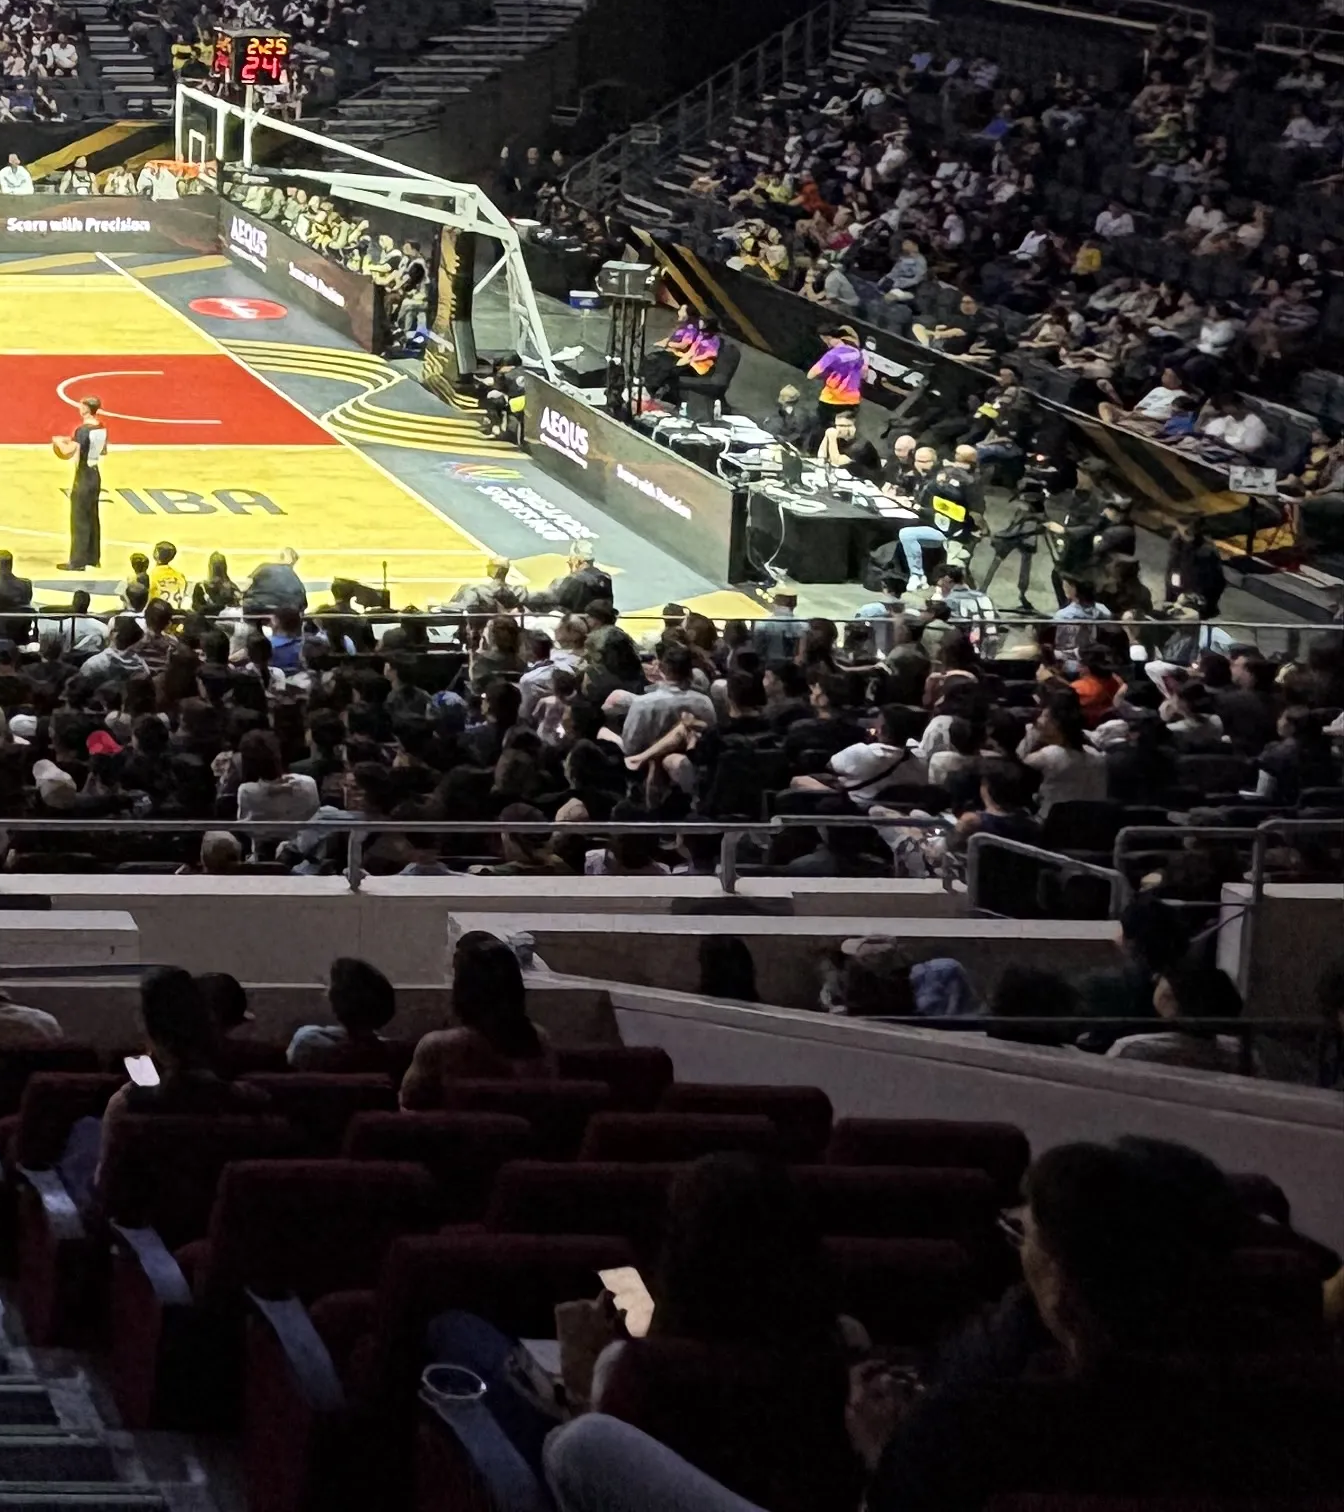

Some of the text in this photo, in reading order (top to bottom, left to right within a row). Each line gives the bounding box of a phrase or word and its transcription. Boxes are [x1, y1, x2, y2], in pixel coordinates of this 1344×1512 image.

[241, 56, 279, 79] 24
[6, 217, 150, 233] Score with Precision
[541, 406, 590, 456] AEQUS
